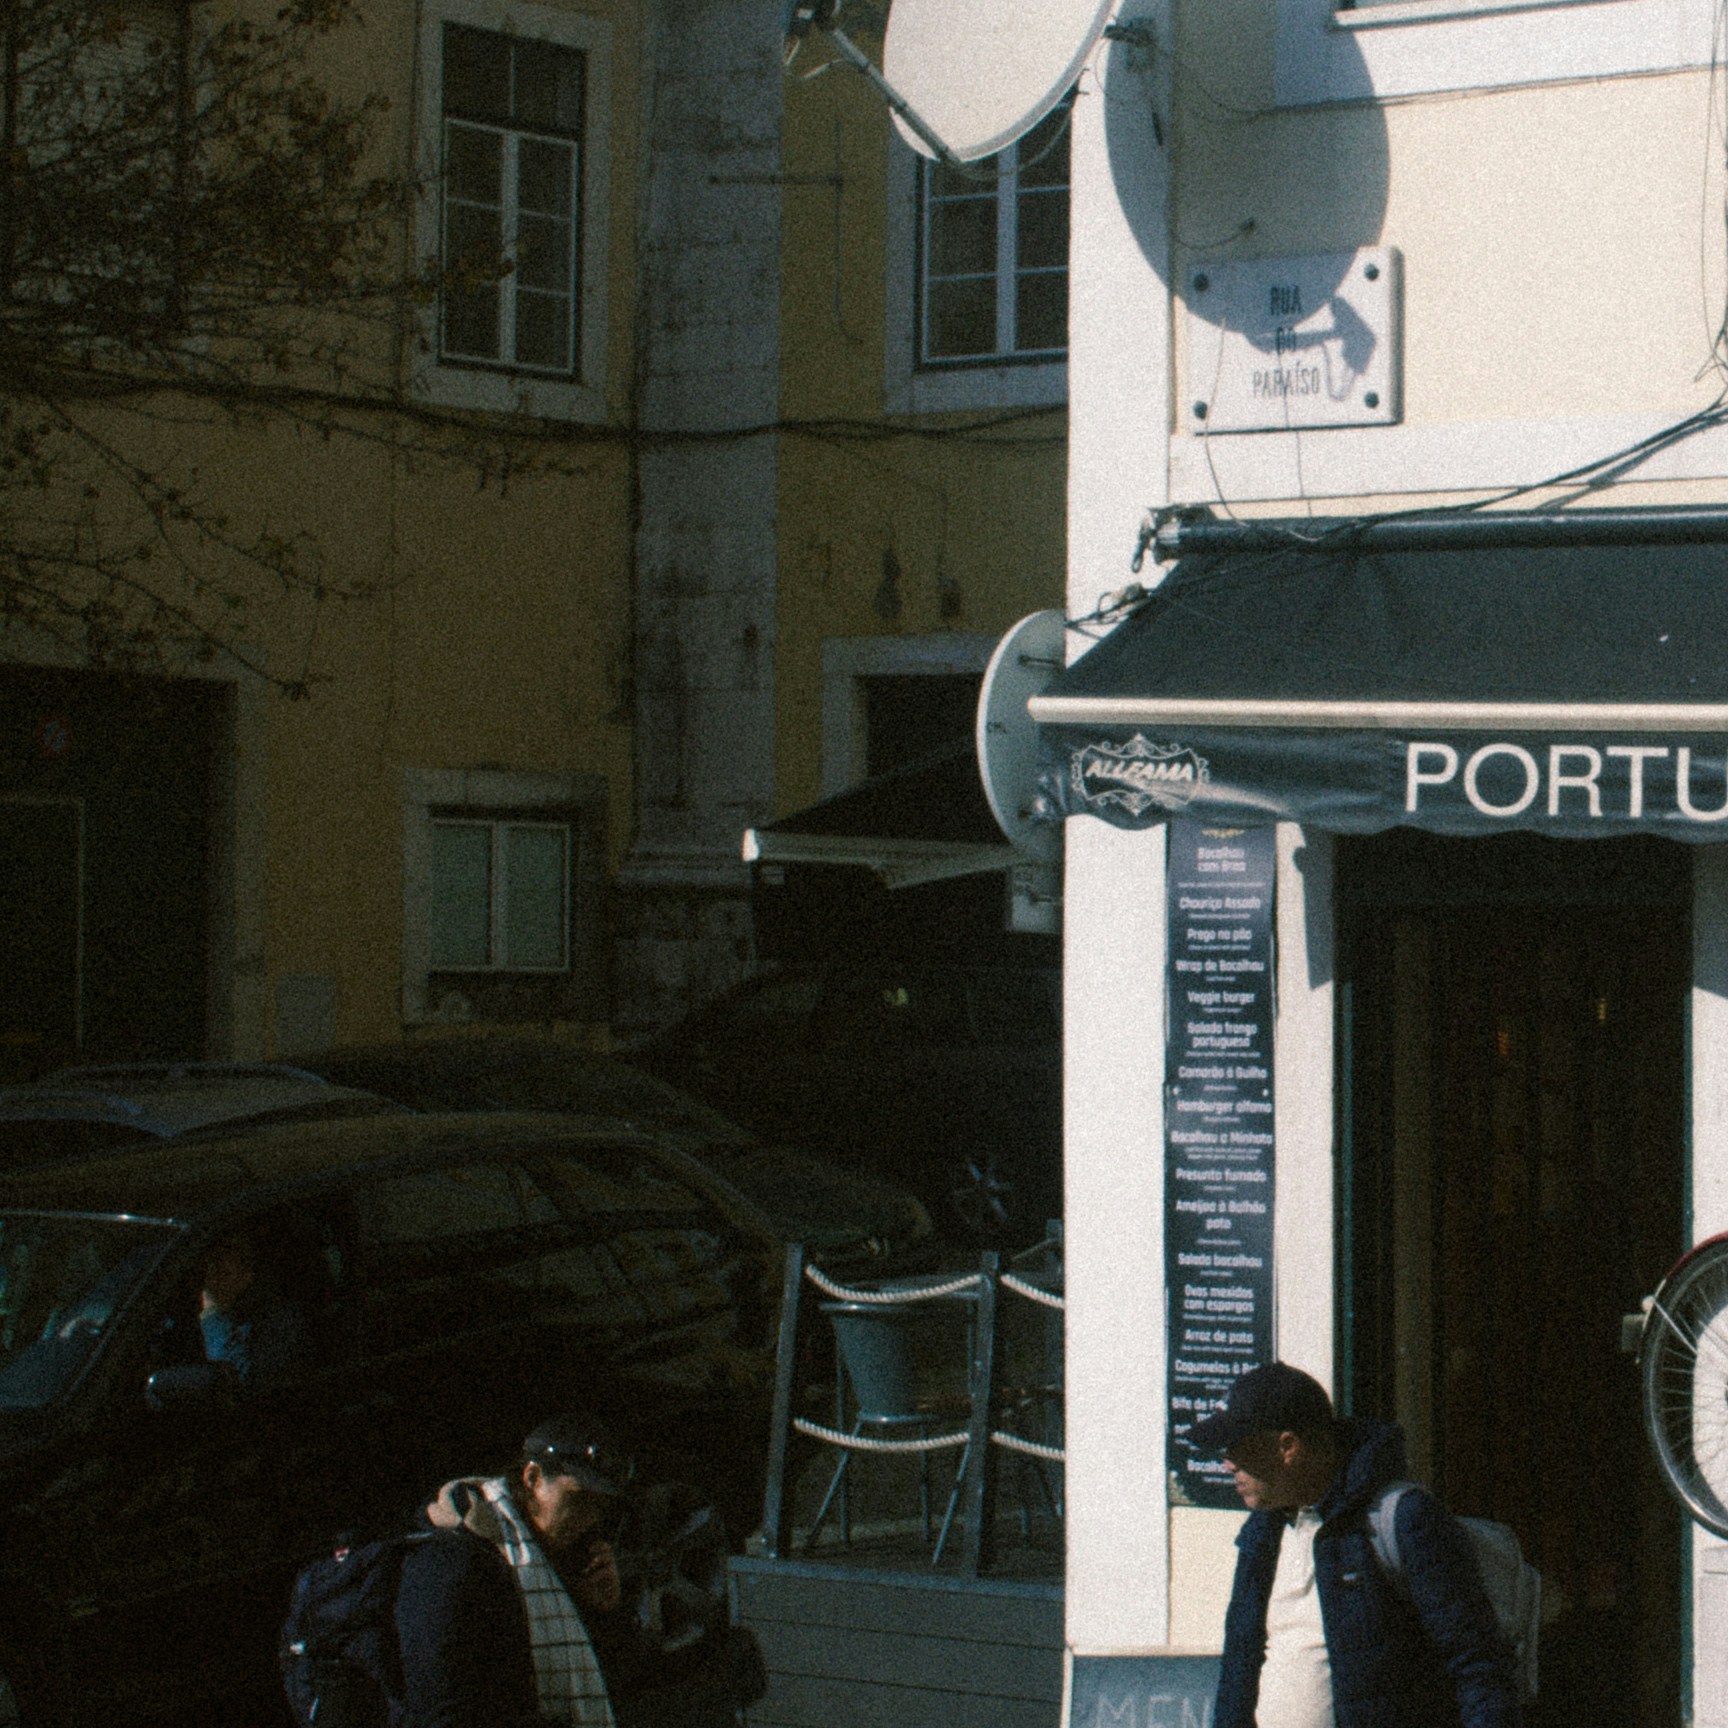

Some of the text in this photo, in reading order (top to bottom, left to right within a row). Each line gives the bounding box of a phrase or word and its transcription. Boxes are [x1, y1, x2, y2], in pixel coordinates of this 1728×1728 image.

[1269, 285, 1302, 316] RUA
[1274, 326, 1297, 356] DO
[1251, 361, 1320, 399] PARAÍSO
[1084, 759, 1194, 782] ALLFAMA
